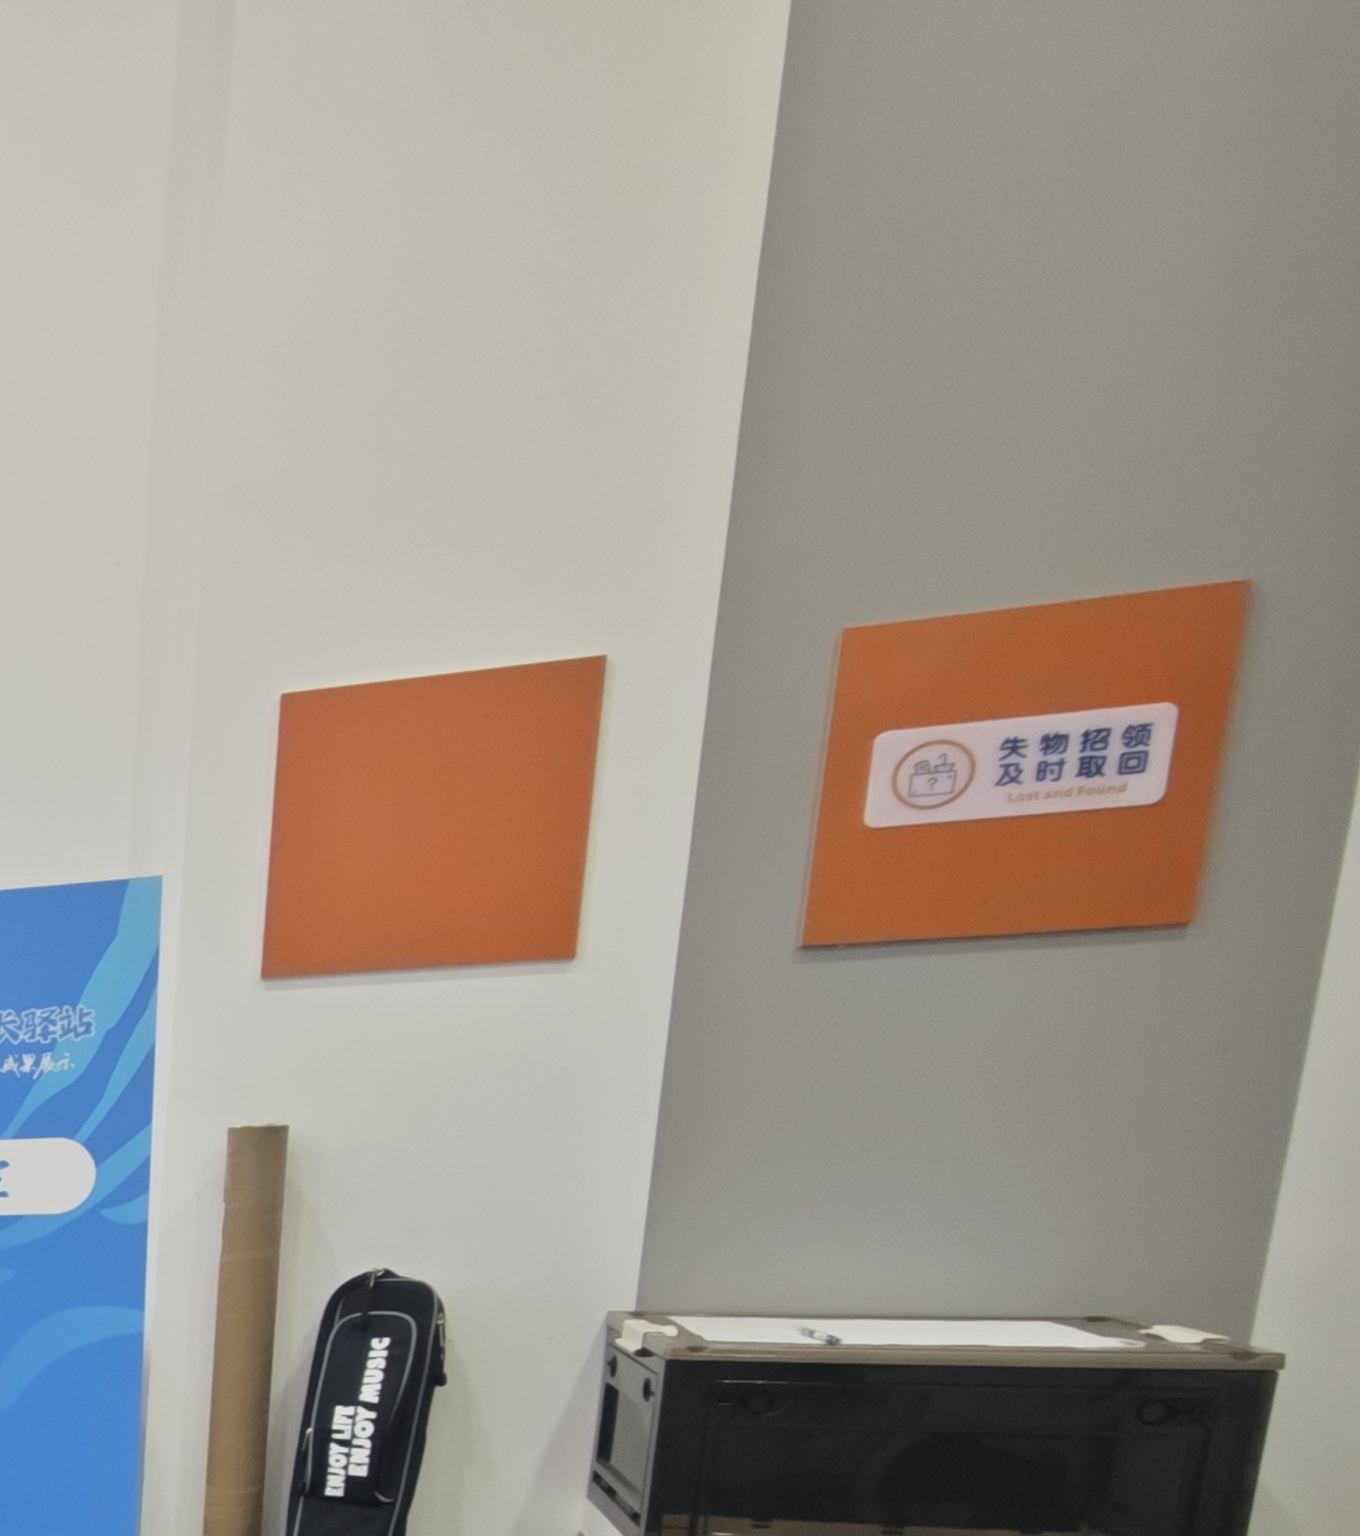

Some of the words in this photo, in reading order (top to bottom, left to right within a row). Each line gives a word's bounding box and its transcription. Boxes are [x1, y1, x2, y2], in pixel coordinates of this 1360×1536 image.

[998, 722, 1154, 762] 失物招领
[994, 750, 1150, 788] 及时取回
[1044, 786, 1073, 800] and
[1077, 782, 1129, 797] Found
[359, 1337, 392, 1404] MUSIC
[331, 1405, 356, 1440] LIFE
[348, 1405, 378, 1478] ENJOY
[324, 1442, 350, 1498] ENJOY
